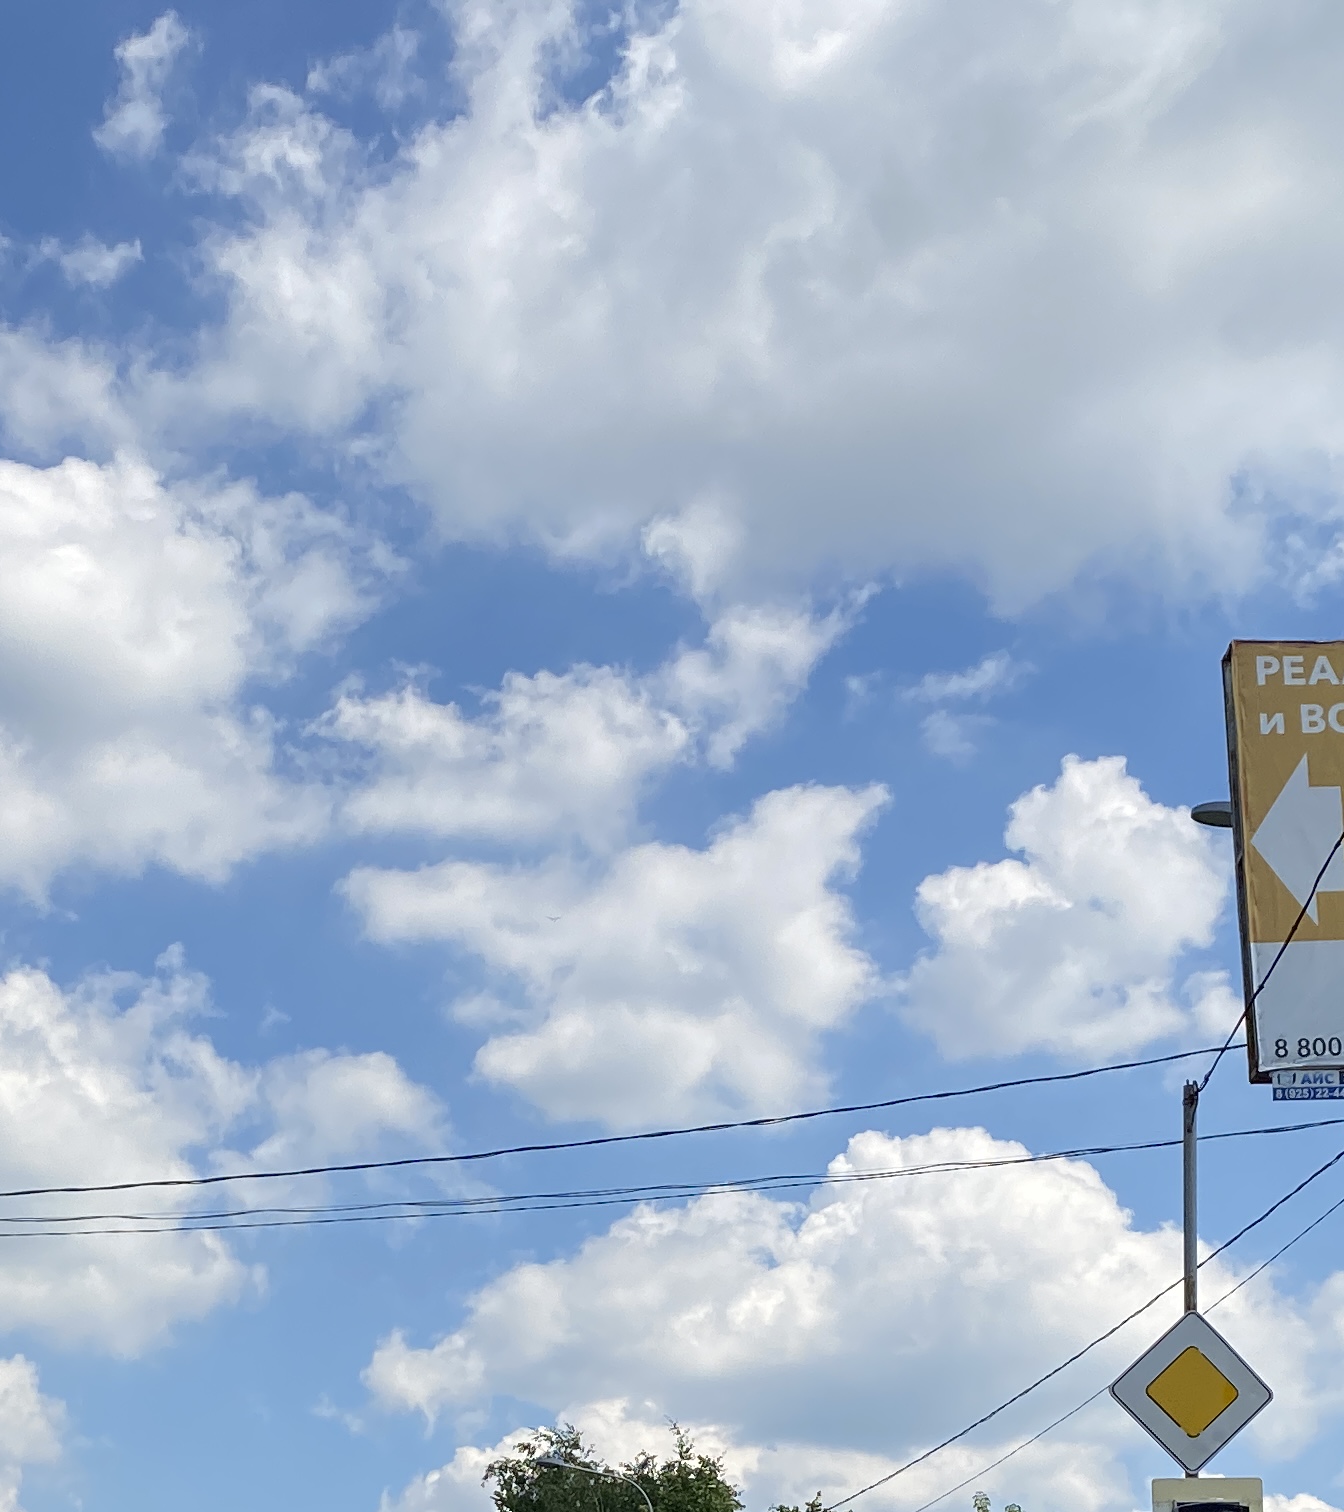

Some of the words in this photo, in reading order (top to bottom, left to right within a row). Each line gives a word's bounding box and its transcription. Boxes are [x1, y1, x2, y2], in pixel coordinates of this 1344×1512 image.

[1259, 712, 1286, 735] и
[1274, 1038, 1289, 1058] 8
[1297, 1036, 1343, 1058] 800
